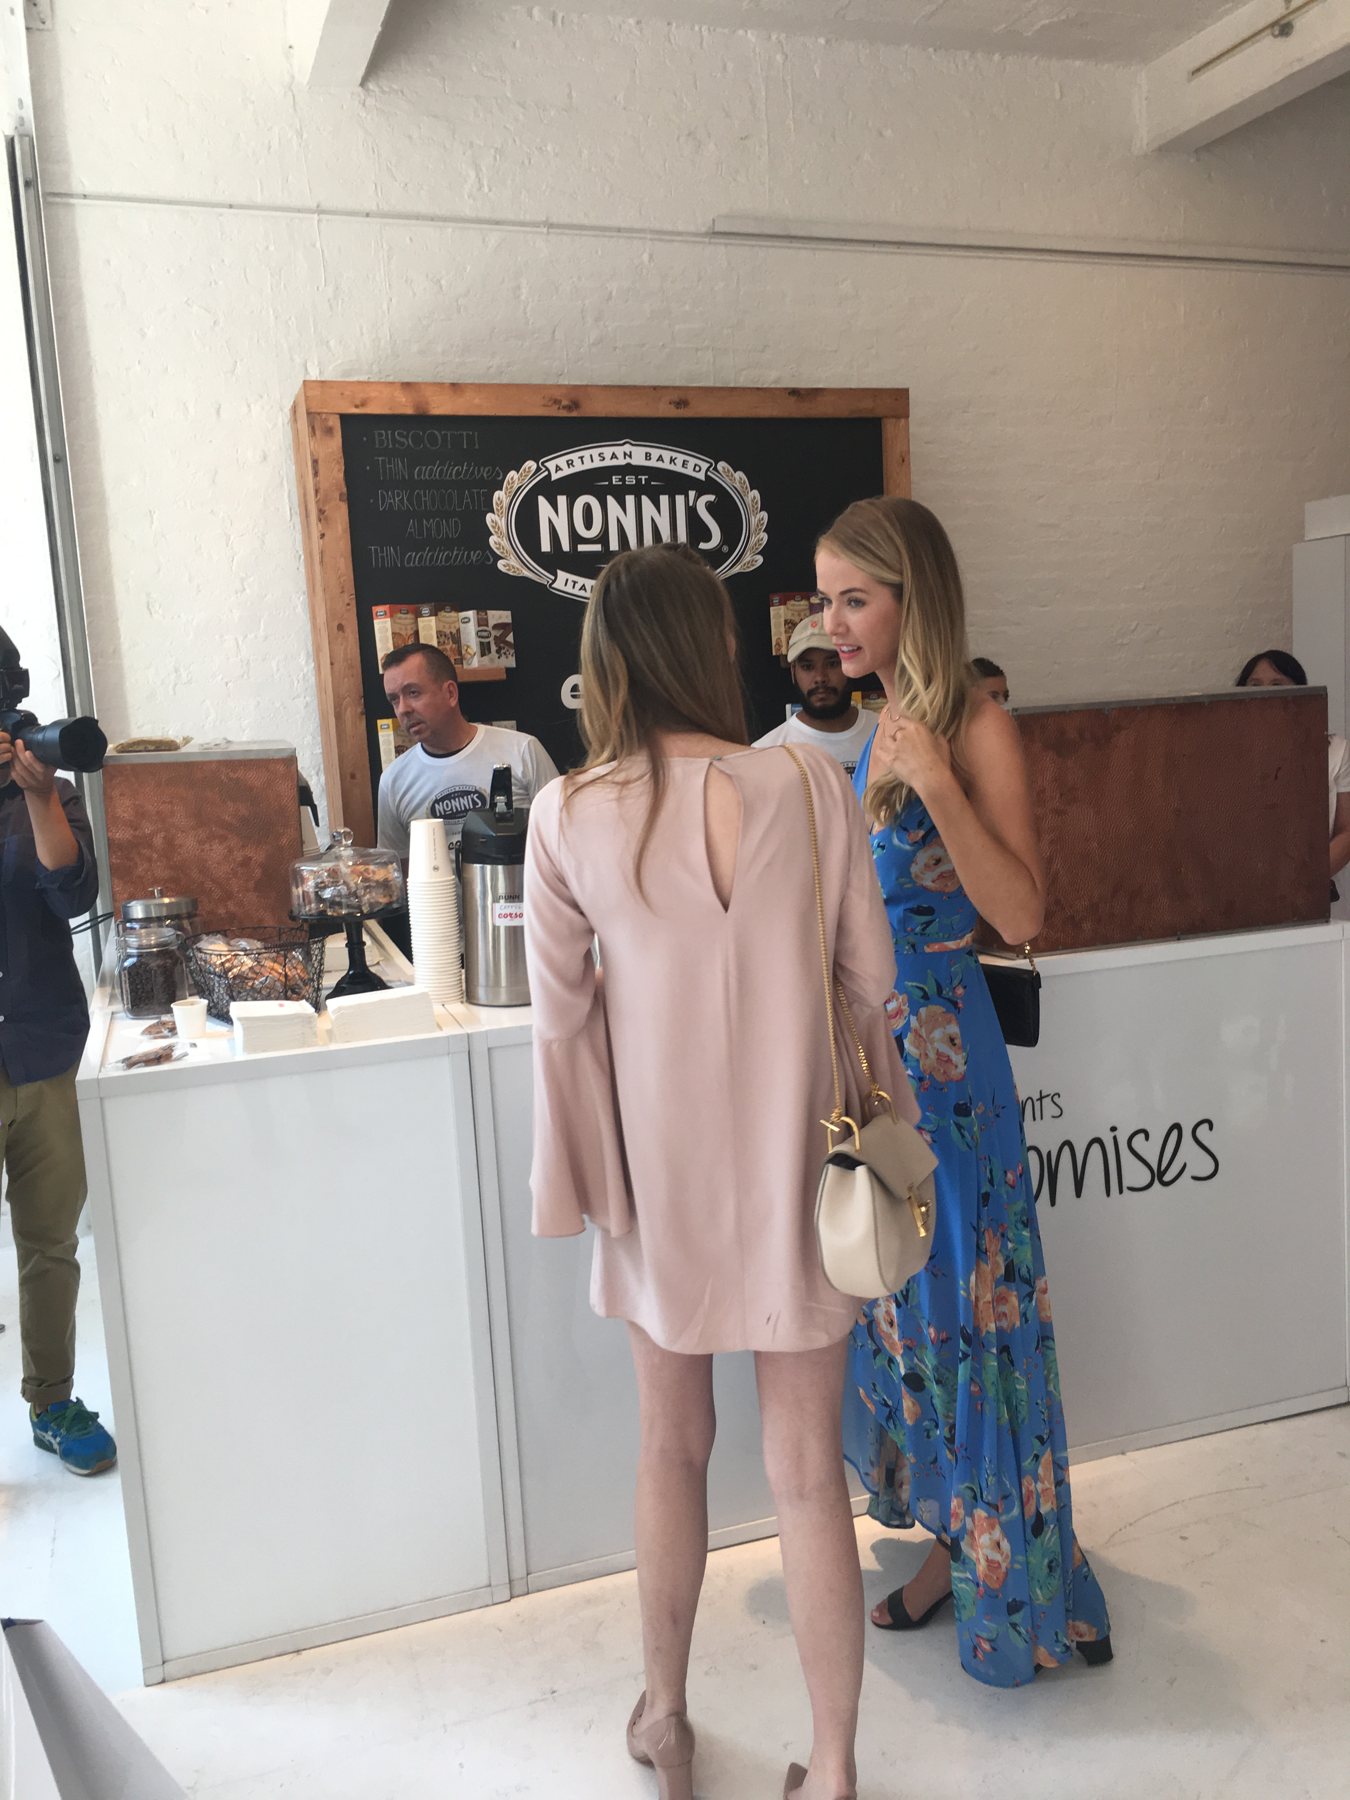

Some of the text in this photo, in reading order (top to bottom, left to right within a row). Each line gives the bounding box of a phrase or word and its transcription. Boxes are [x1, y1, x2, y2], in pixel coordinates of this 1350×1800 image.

[373, 429, 480, 450] BISCOTTI
[375, 456, 504, 481] THIN addictives
[554, 450, 702, 474] ARTISAN BAKED
[612, 475, 649, 485] EST
[378, 488, 490, 511] DARK CHOCOLATE
[405, 517, 462, 539] ALMOND
[537, 489, 719, 552] NONNI'S
[368, 545, 494, 569] THIN addictives
[434, 793, 482, 817] NONNI'S
